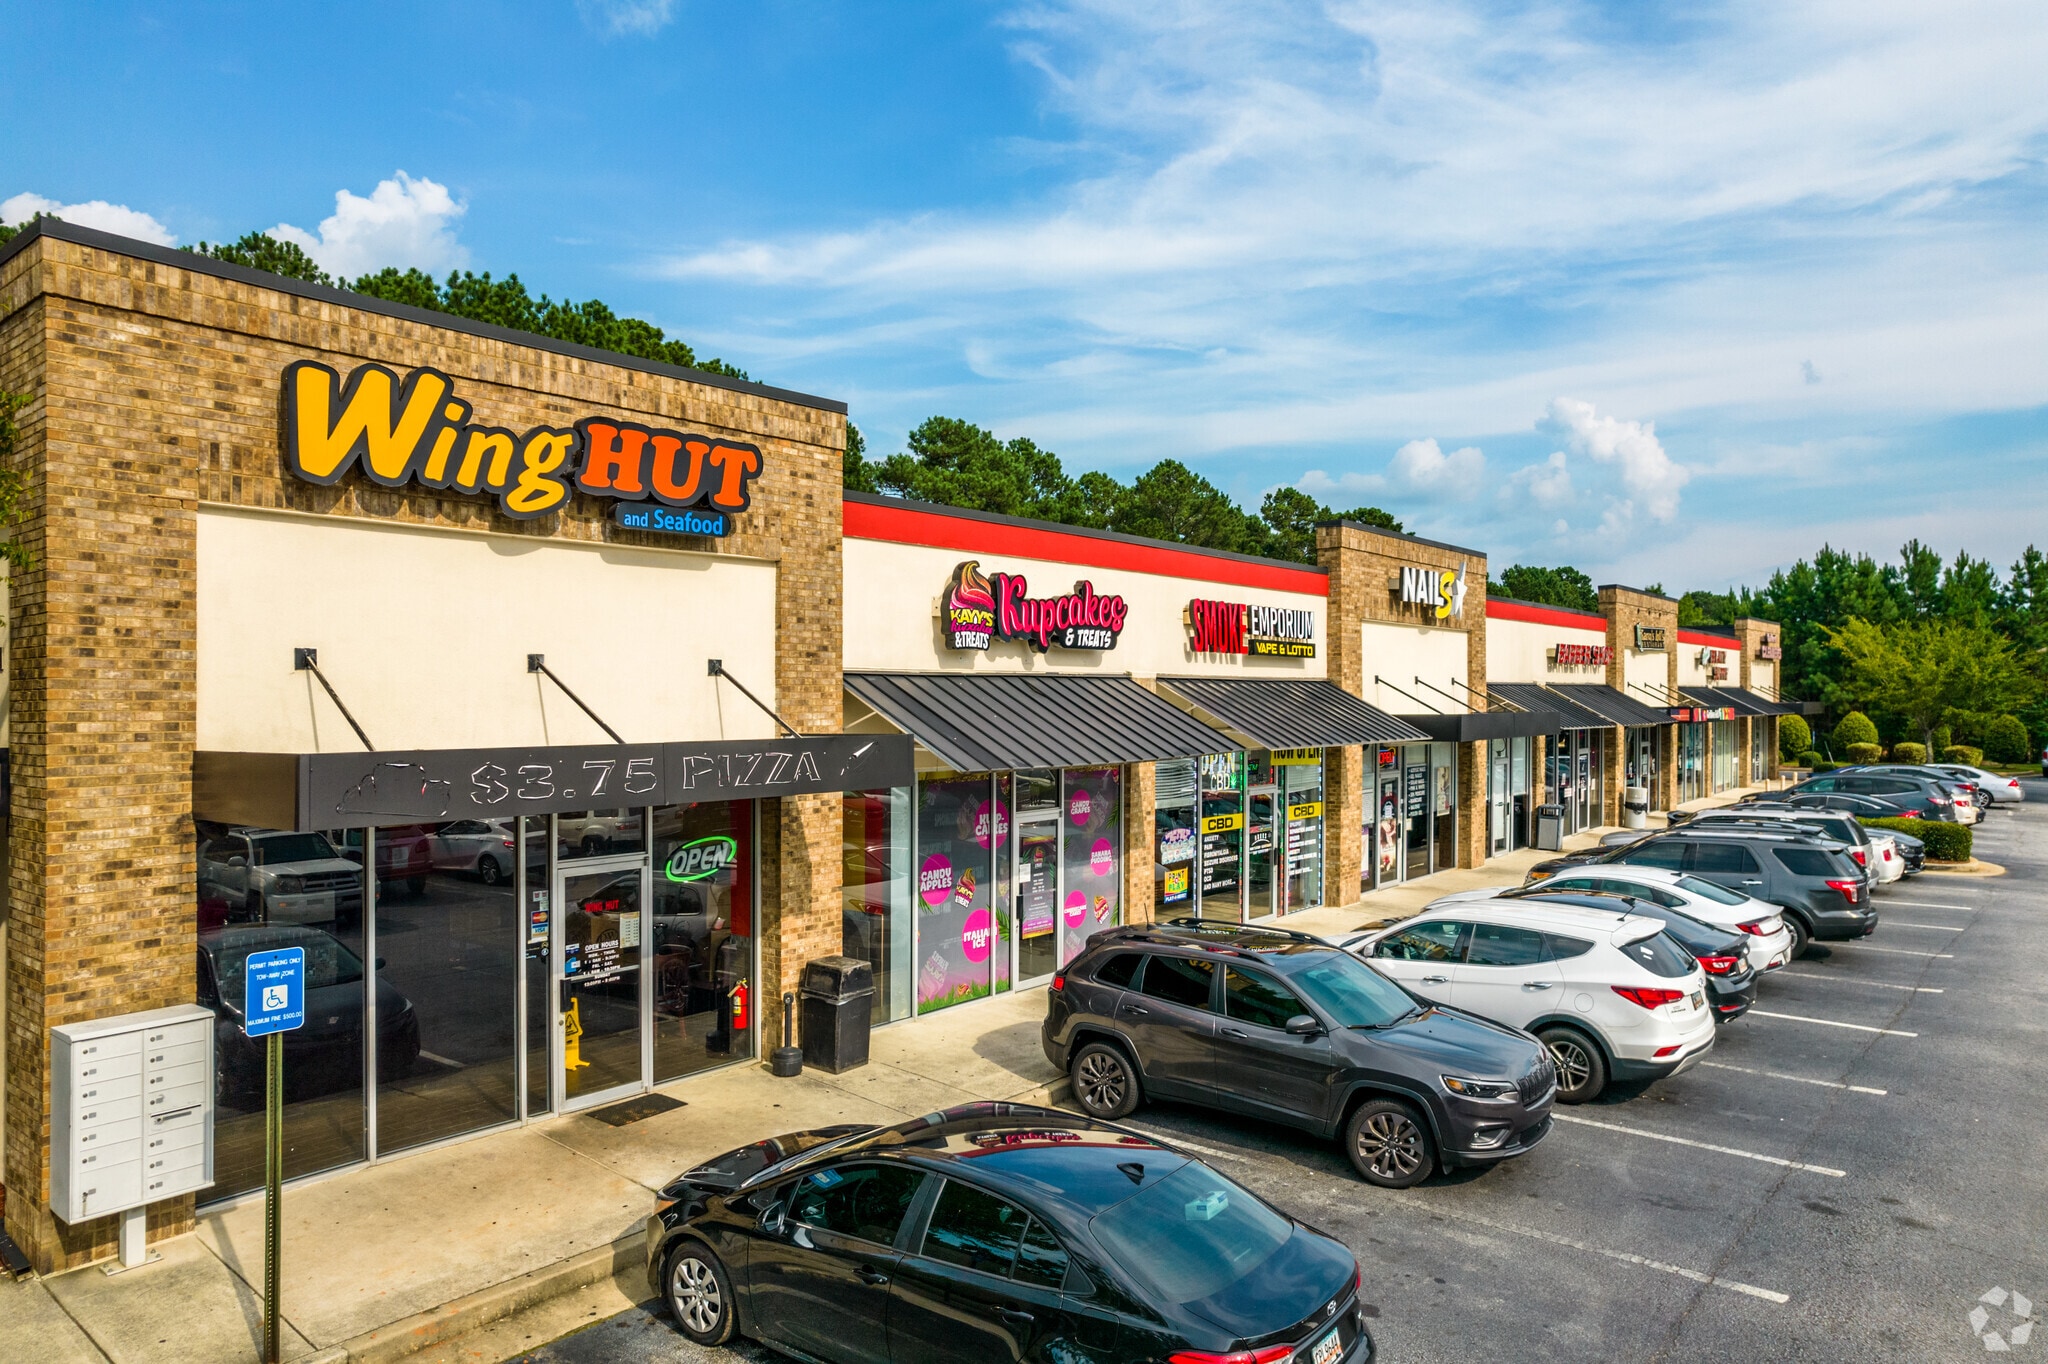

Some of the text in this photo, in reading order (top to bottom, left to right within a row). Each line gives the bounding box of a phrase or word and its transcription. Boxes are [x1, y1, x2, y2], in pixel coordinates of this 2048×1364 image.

[295, 365, 758, 514] Wing HUT
[623, 508, 723, 536] and Seafood
[1402, 566, 1455, 620] NAILS
[950, 608, 995, 627] KAYY'S
[999, 572, 1128, 648] Kupcakes
[1193, 598, 1314, 655] SMOKE EMPORIUM
[1065, 628, 1111, 649] & TREATS
[1255, 641, 1313, 657] VAPE & LOTTO
[470, 750, 822, 805] $3.75 PIZZA
[1211, 771, 1230, 791] CBD
[1294, 805, 1315, 818] CBD
[1207, 816, 1234, 831] CBD
[669, 842, 731, 875] OPEN
[920, 877, 952, 892] APPLES
[963, 926, 998, 943] ITALIA
[972, 937, 986, 949] ICE
[584, 939, 619, 952] OPEN HOURS
[249, 957, 301, 970] PERMIT PARKING ONLY
[256, 969, 295, 981] TOW-AWAY ZONE
[247, 1016, 270, 1026] MAXIMUM
[270, 1014, 281, 1022] FINE
